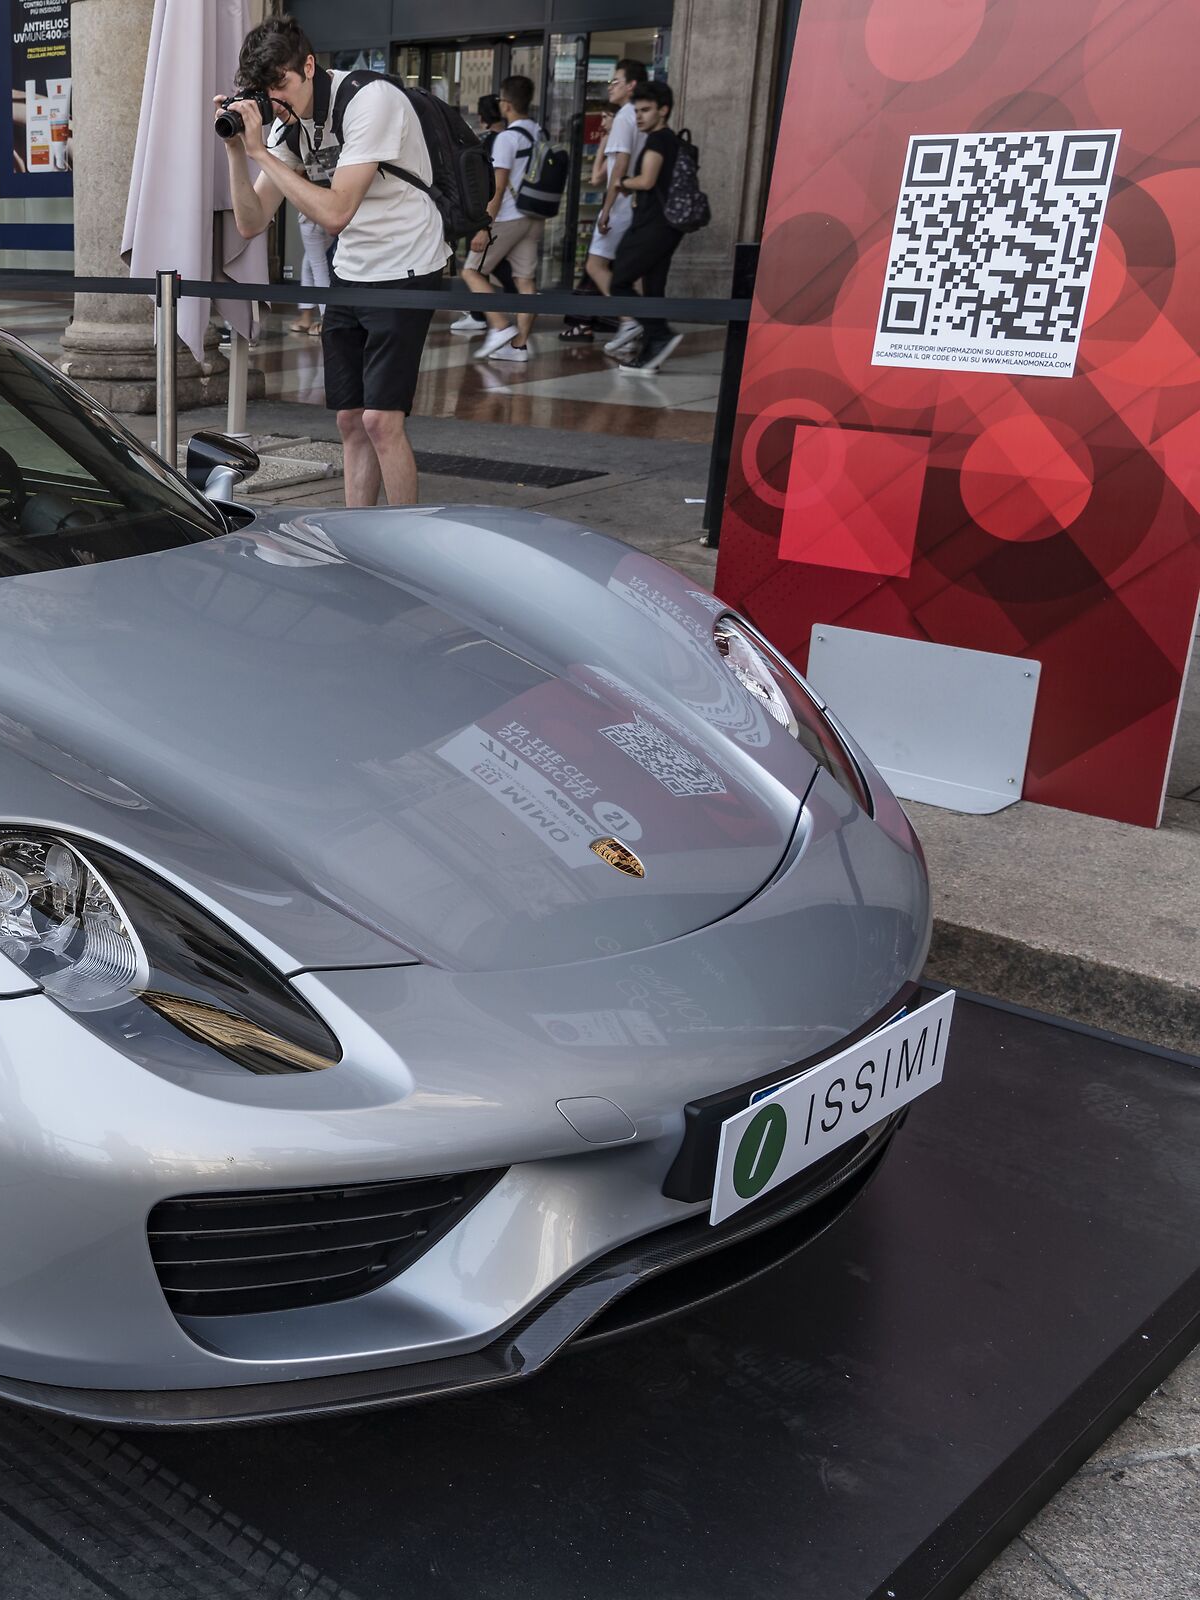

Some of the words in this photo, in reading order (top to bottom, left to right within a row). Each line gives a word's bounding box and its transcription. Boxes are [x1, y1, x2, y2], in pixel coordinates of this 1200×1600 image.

[23, 18, 69, 33] ANTHELIOS
[876, 350, 913, 360] SCANSIONA
[932, 354, 950, 362] CODE
[981, 357, 1072, 369] WWW.MILANOMONZA.COM
[904, 344, 936, 352] ULTERIORI
[936, 346, 984, 355] INFORMAZIONI
[984, 348, 994, 356] SU
[995, 349, 1024, 358] QUESTO
[1024, 351, 1058, 360] MODELLO
[804, 1018, 943, 1146] ISSIMI
